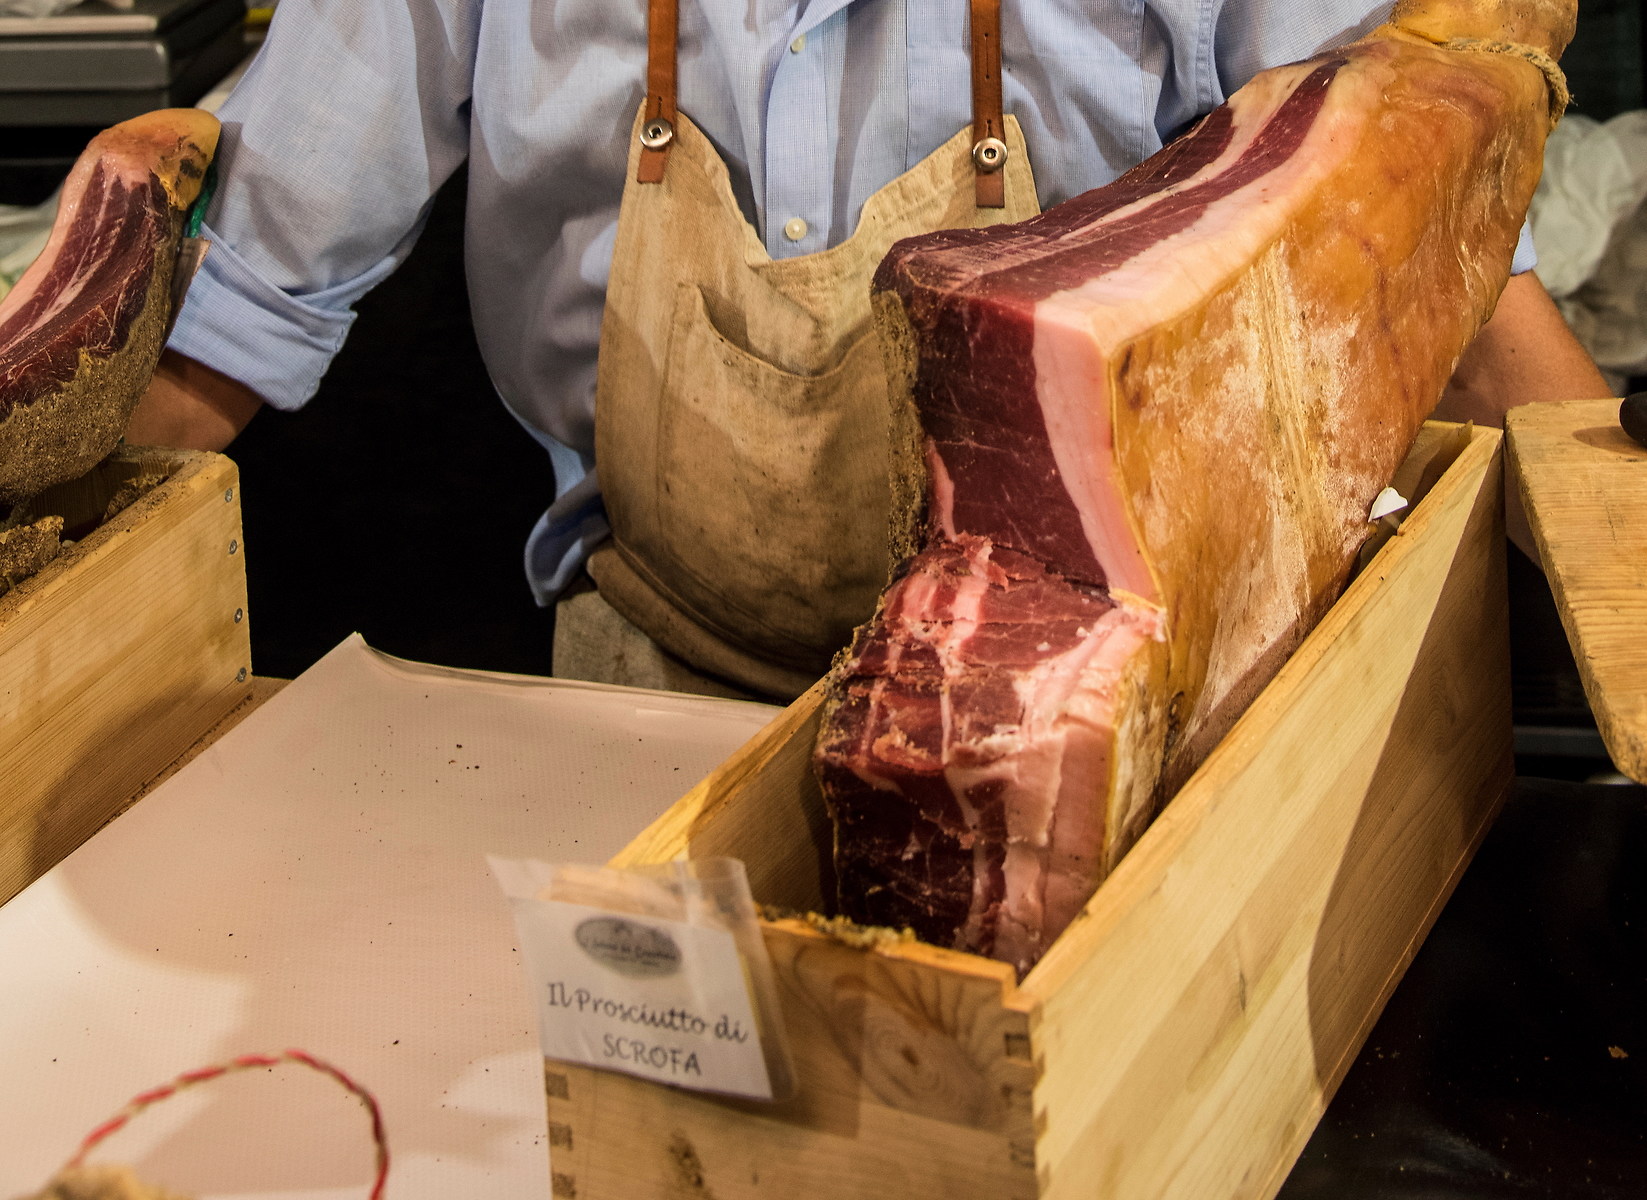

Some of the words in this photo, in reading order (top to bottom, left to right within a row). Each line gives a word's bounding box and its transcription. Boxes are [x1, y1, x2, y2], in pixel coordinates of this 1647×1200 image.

[548, 982, 572, 1008] Il
[574, 987, 708, 1033] Prosciutto
[714, 1014, 749, 1044] di
[603, 1032, 702, 1076] SCROFA
